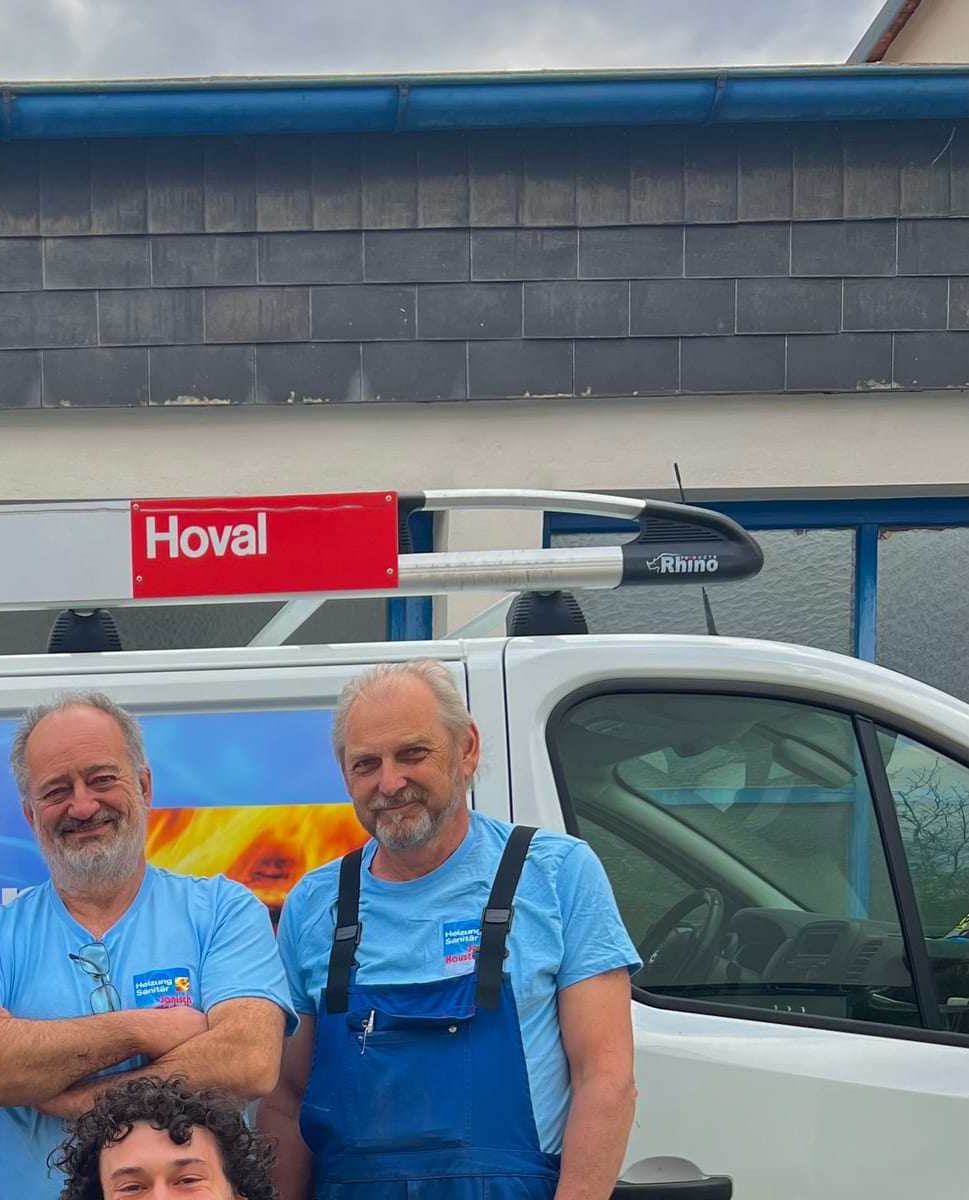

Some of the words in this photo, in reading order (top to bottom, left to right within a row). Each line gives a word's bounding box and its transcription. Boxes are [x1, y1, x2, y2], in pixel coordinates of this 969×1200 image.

[146, 512, 267, 559] Hoval
[661, 554, 719, 573] Rhino
[135, 978, 173, 989] Heizung
